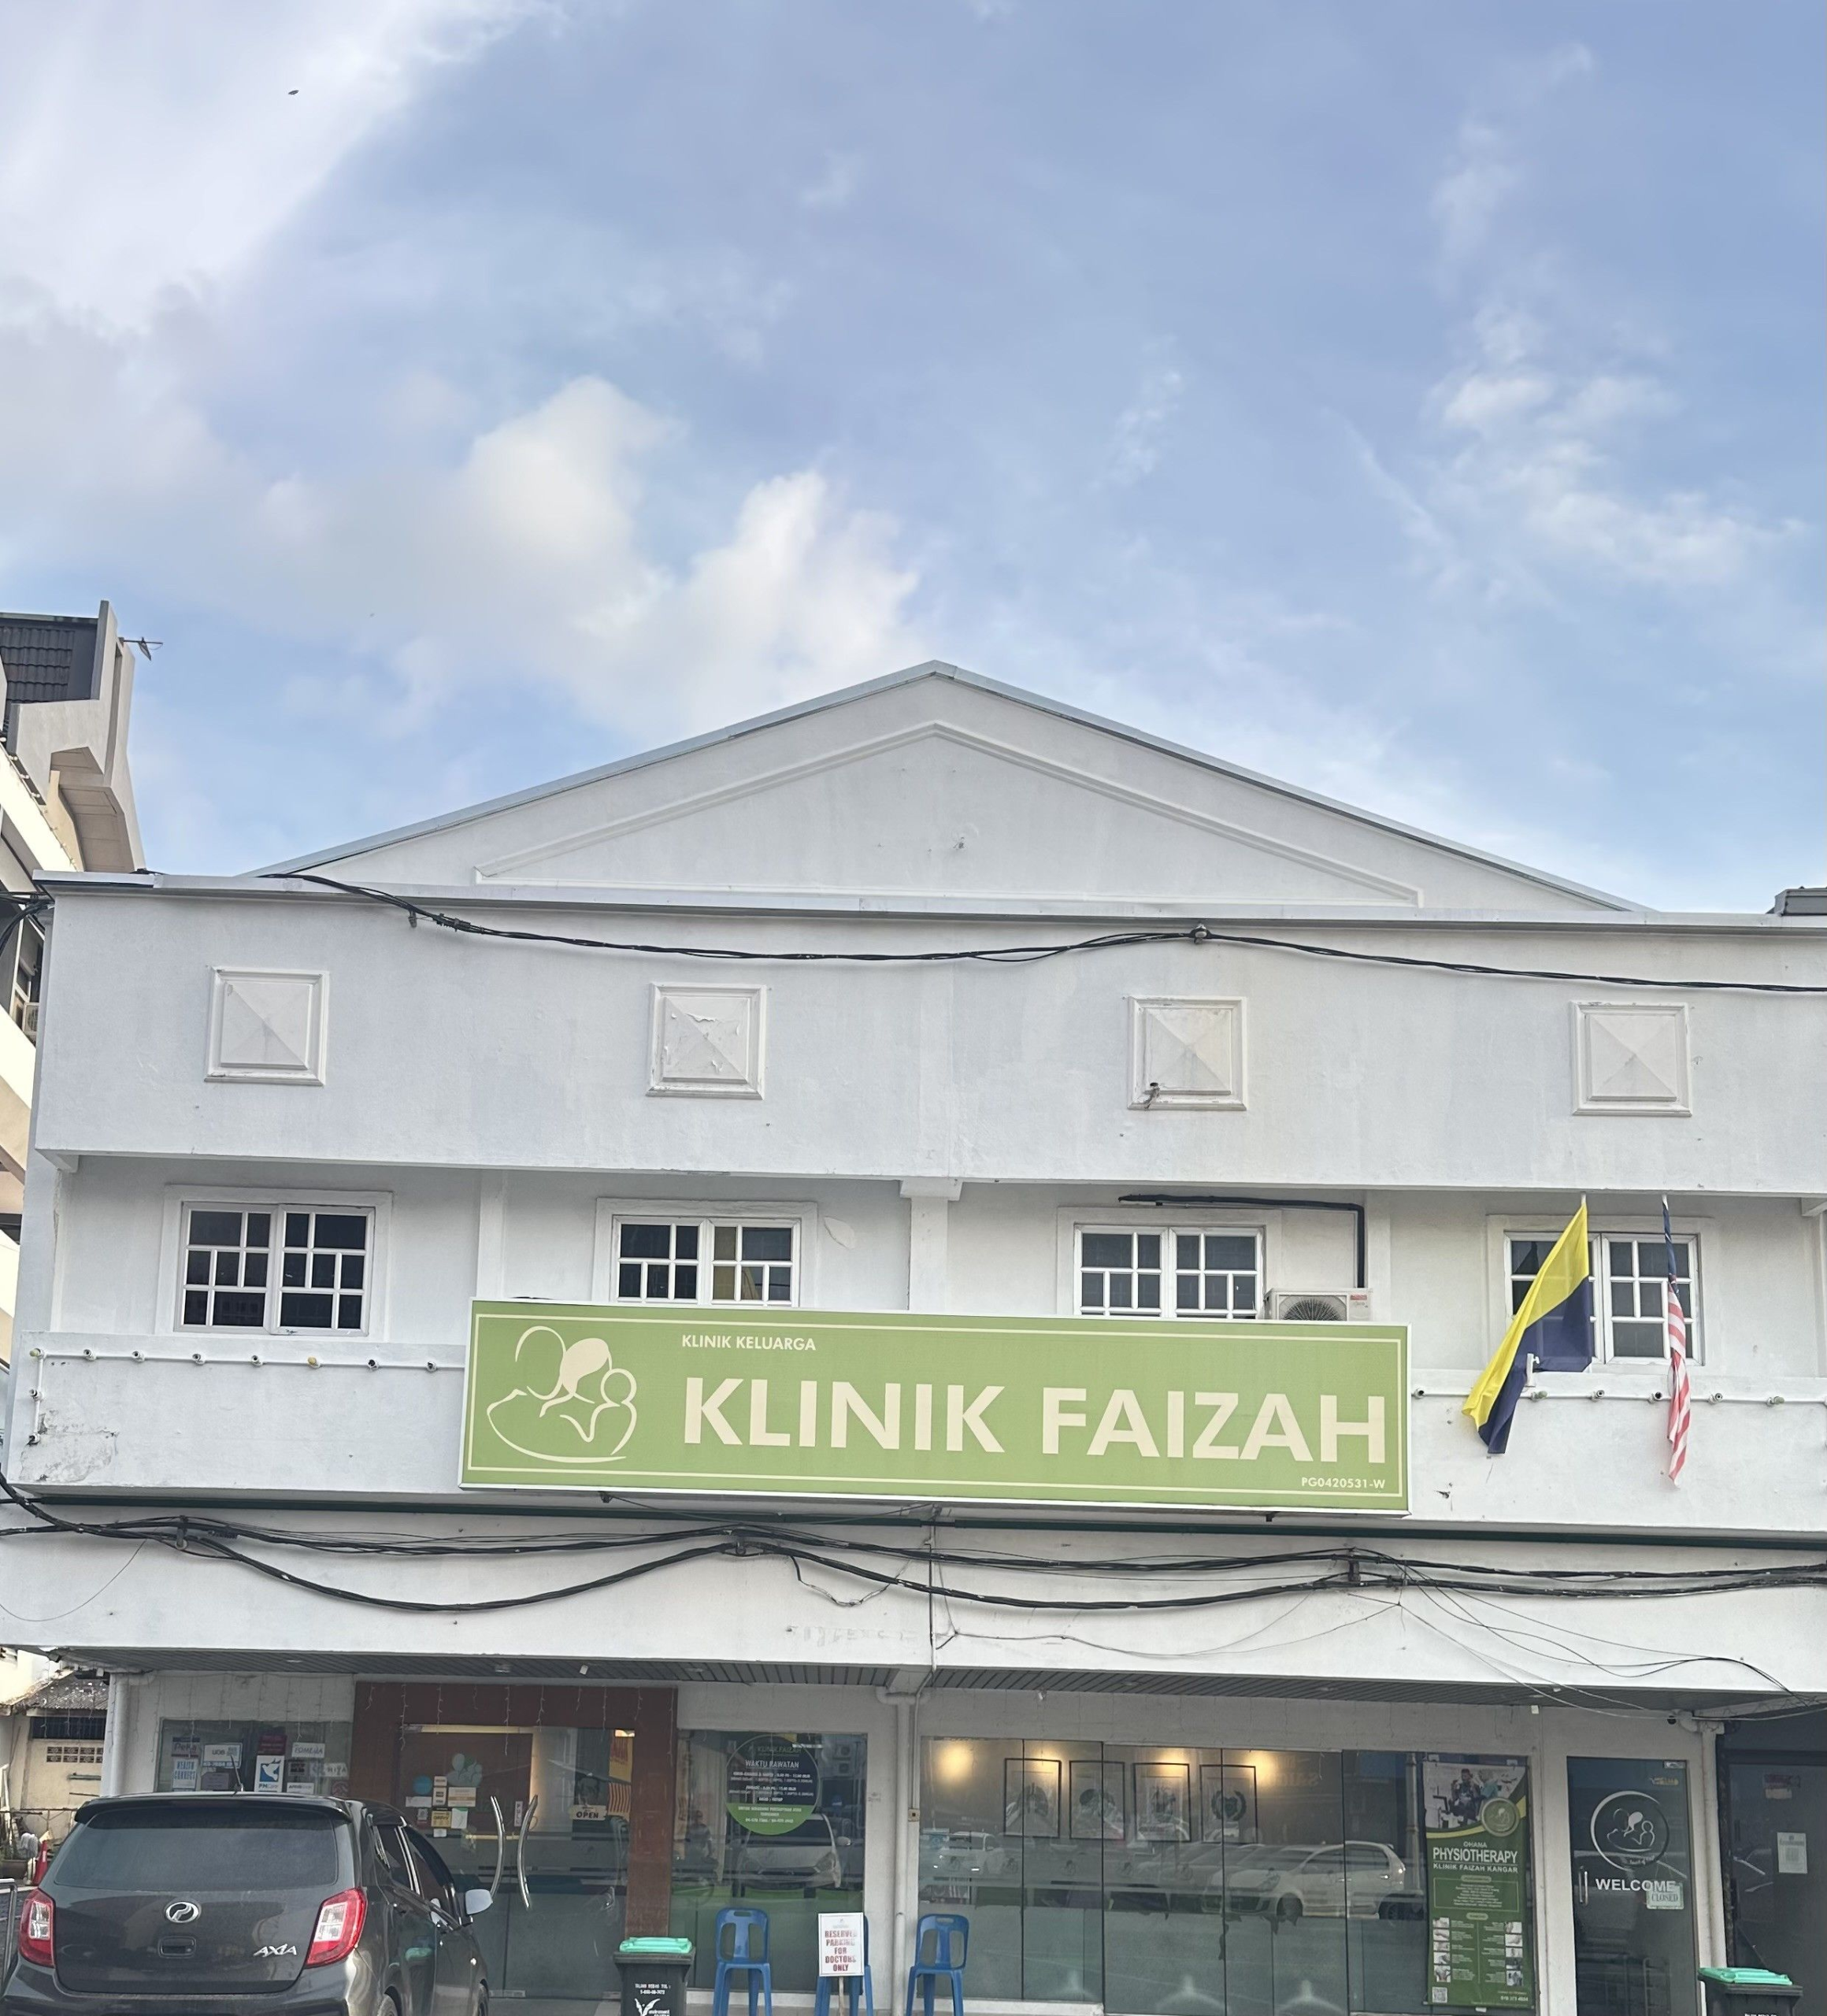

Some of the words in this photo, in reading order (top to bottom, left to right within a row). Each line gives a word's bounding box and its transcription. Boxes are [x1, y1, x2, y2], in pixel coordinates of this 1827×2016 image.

[682, 1335, 732, 1349] KLINIK
[736, 1336, 817, 1351] KELUARGA
[684, 1377, 1006, 1453] KLINIK
[1041, 1386, 1387, 1465] FAIZAH
[1301, 1477, 1386, 1490] PG0420531-W
[576, 1810, 599, 1819] OPEN
[1432, 1847, 1518, 1864] PHYSIOTHERAPY
[1595, 1878, 1677, 1892] WELCOME
[253, 1943, 297, 1958] AXIA
[825, 1955, 857, 1964] DOCTORS
[832, 1963, 849, 1972] ONLY
